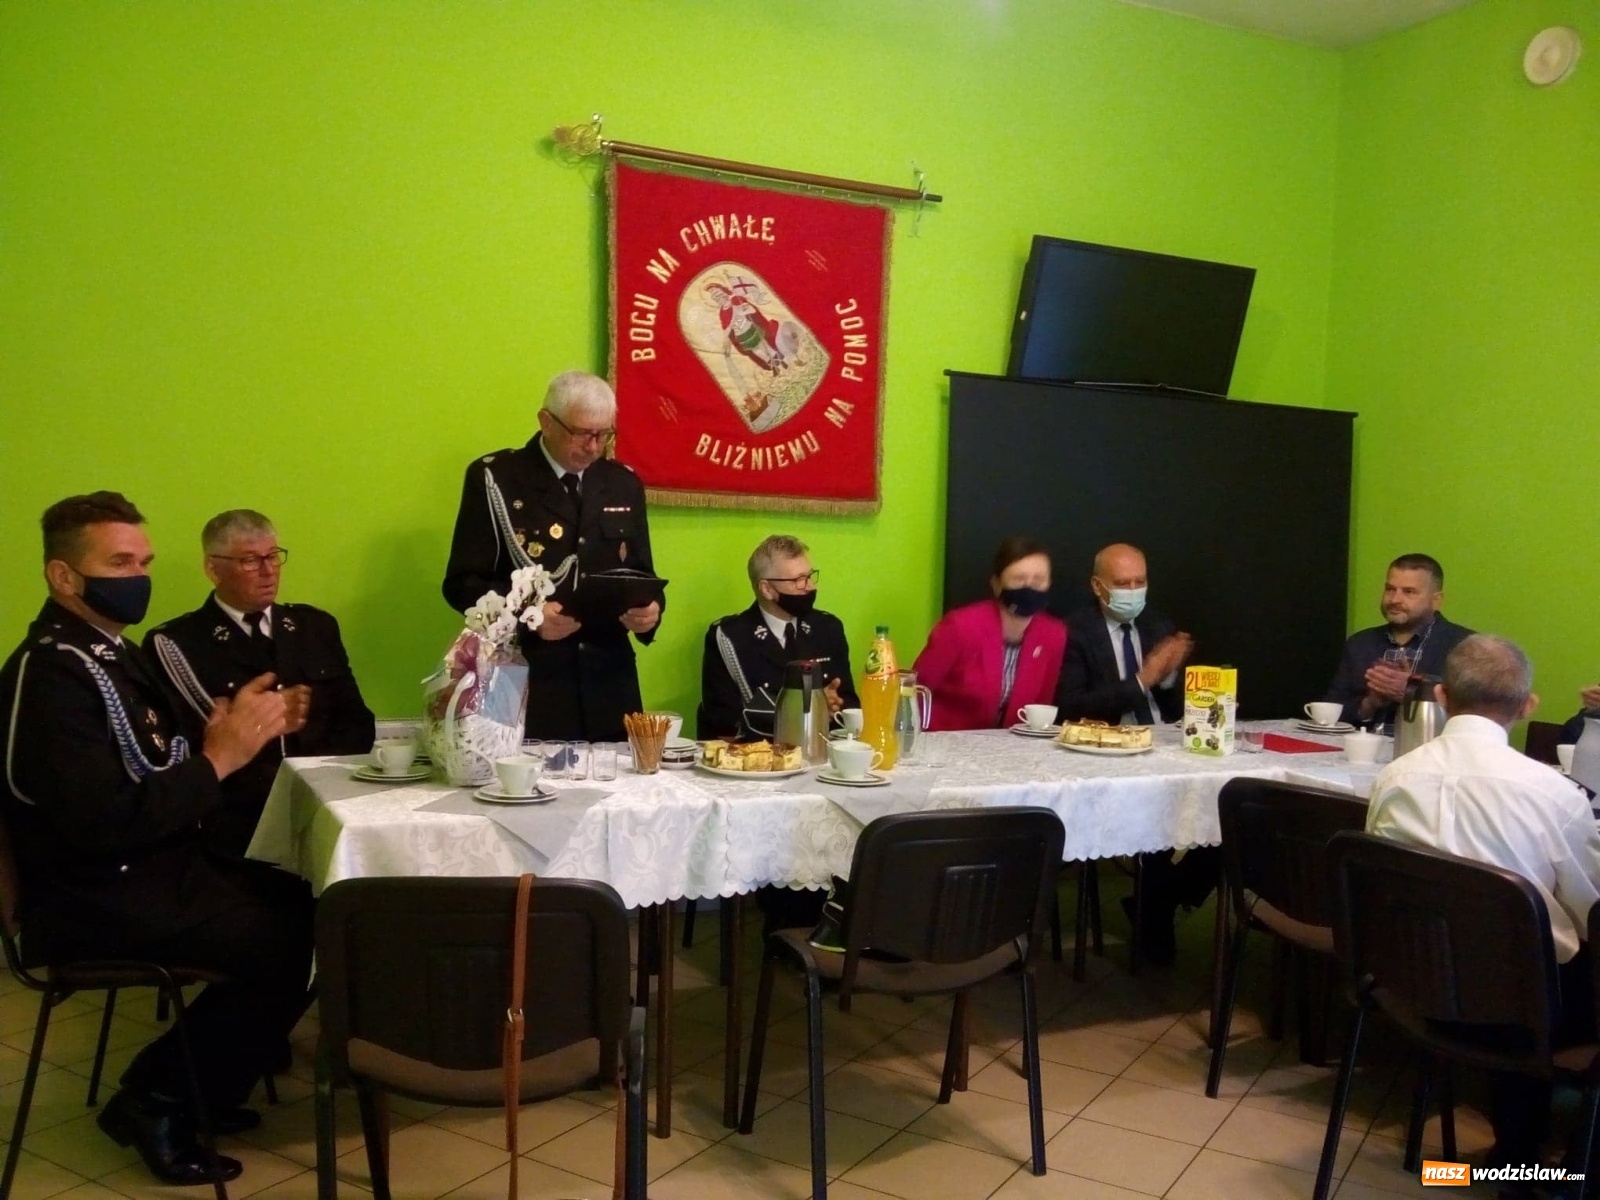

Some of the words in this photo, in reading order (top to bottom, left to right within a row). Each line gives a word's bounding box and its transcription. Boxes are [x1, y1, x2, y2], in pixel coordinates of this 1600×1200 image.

[630, 293, 659, 362] BOGU
[646, 248, 680, 283] NA
[680, 213, 775, 253] CHWAŁĘ
[835, 298, 867, 382] POMOC
[824, 398, 854, 429] NA
[1186, 671, 1201, 691] 2L
